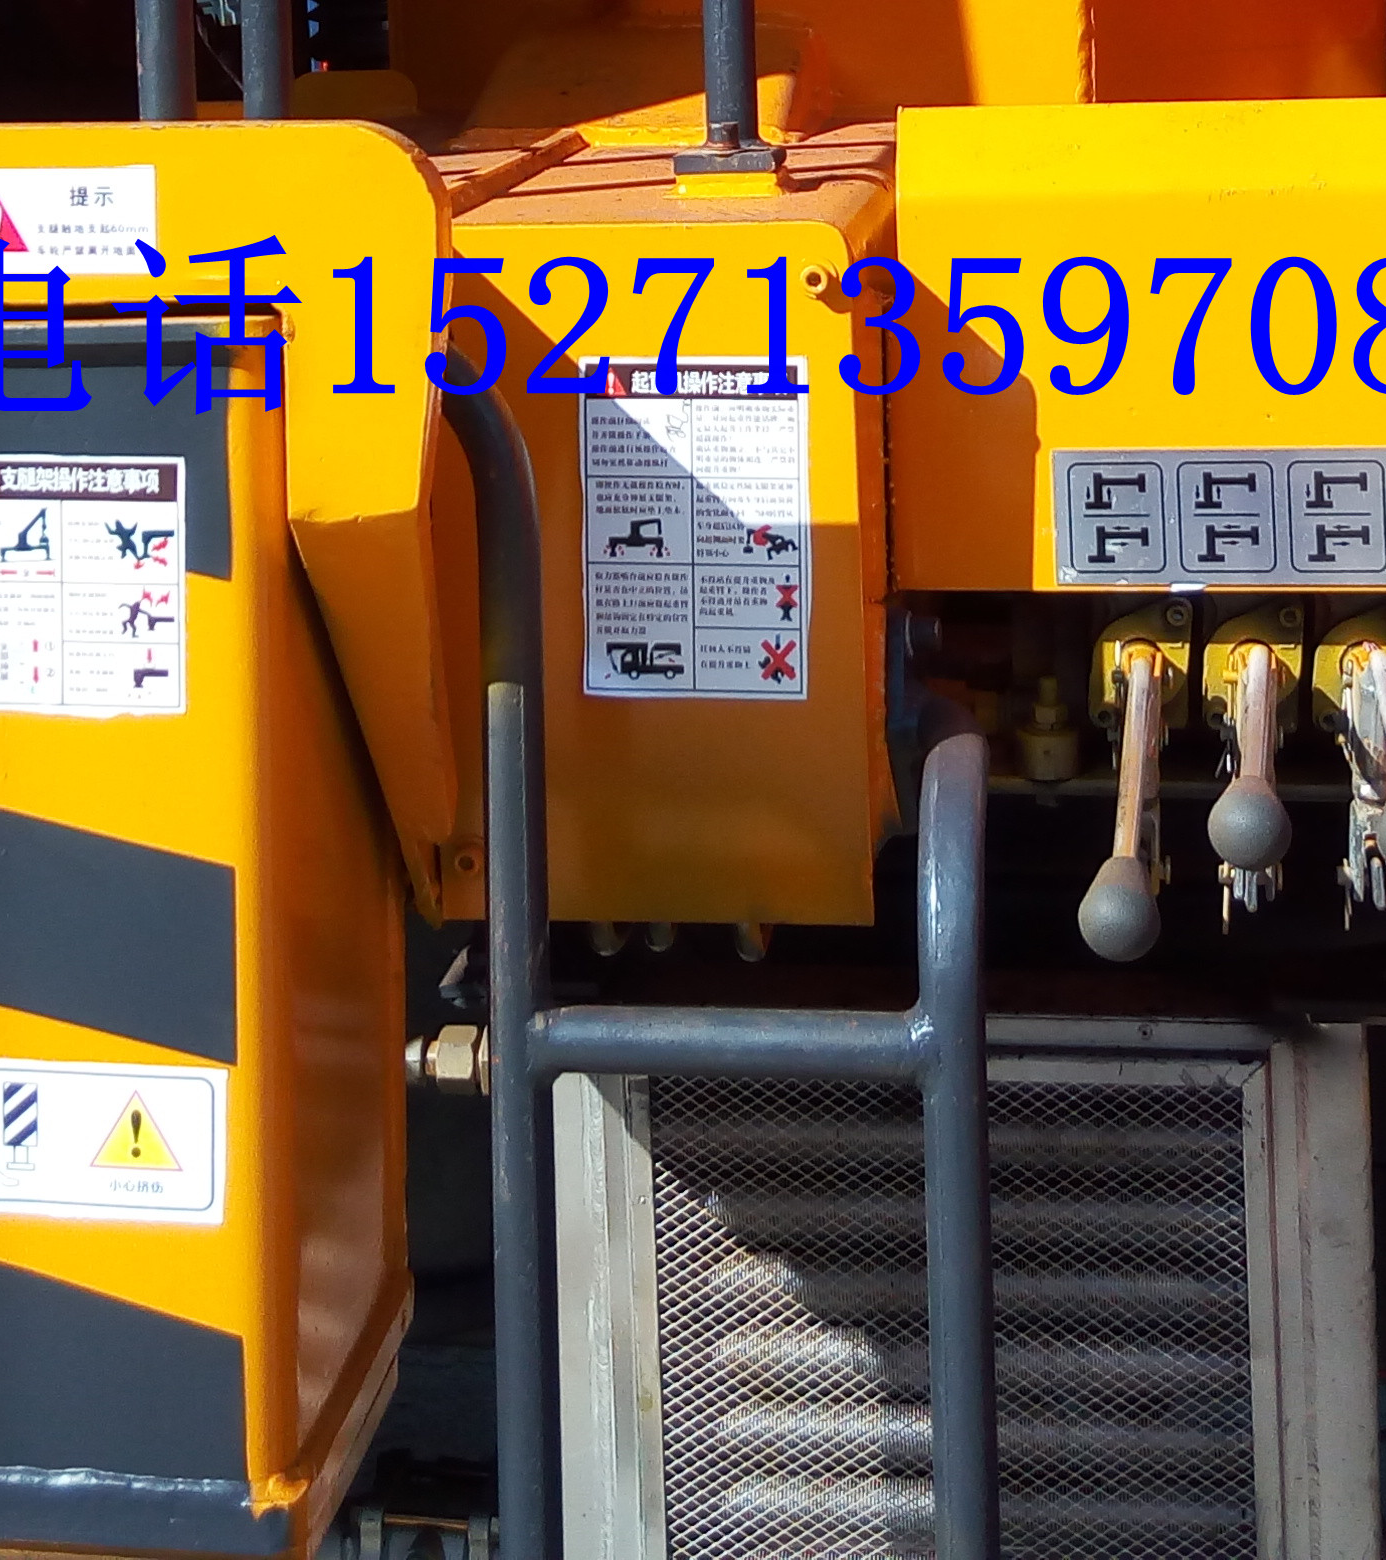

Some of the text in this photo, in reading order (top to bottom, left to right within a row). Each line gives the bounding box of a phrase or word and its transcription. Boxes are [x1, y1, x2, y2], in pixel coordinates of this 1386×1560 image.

[69, 186, 115, 208] 提示
[0, 465, 160, 495] 支腿架操作注意事项
[108, 1179, 165, 1194] 小心挤伤
